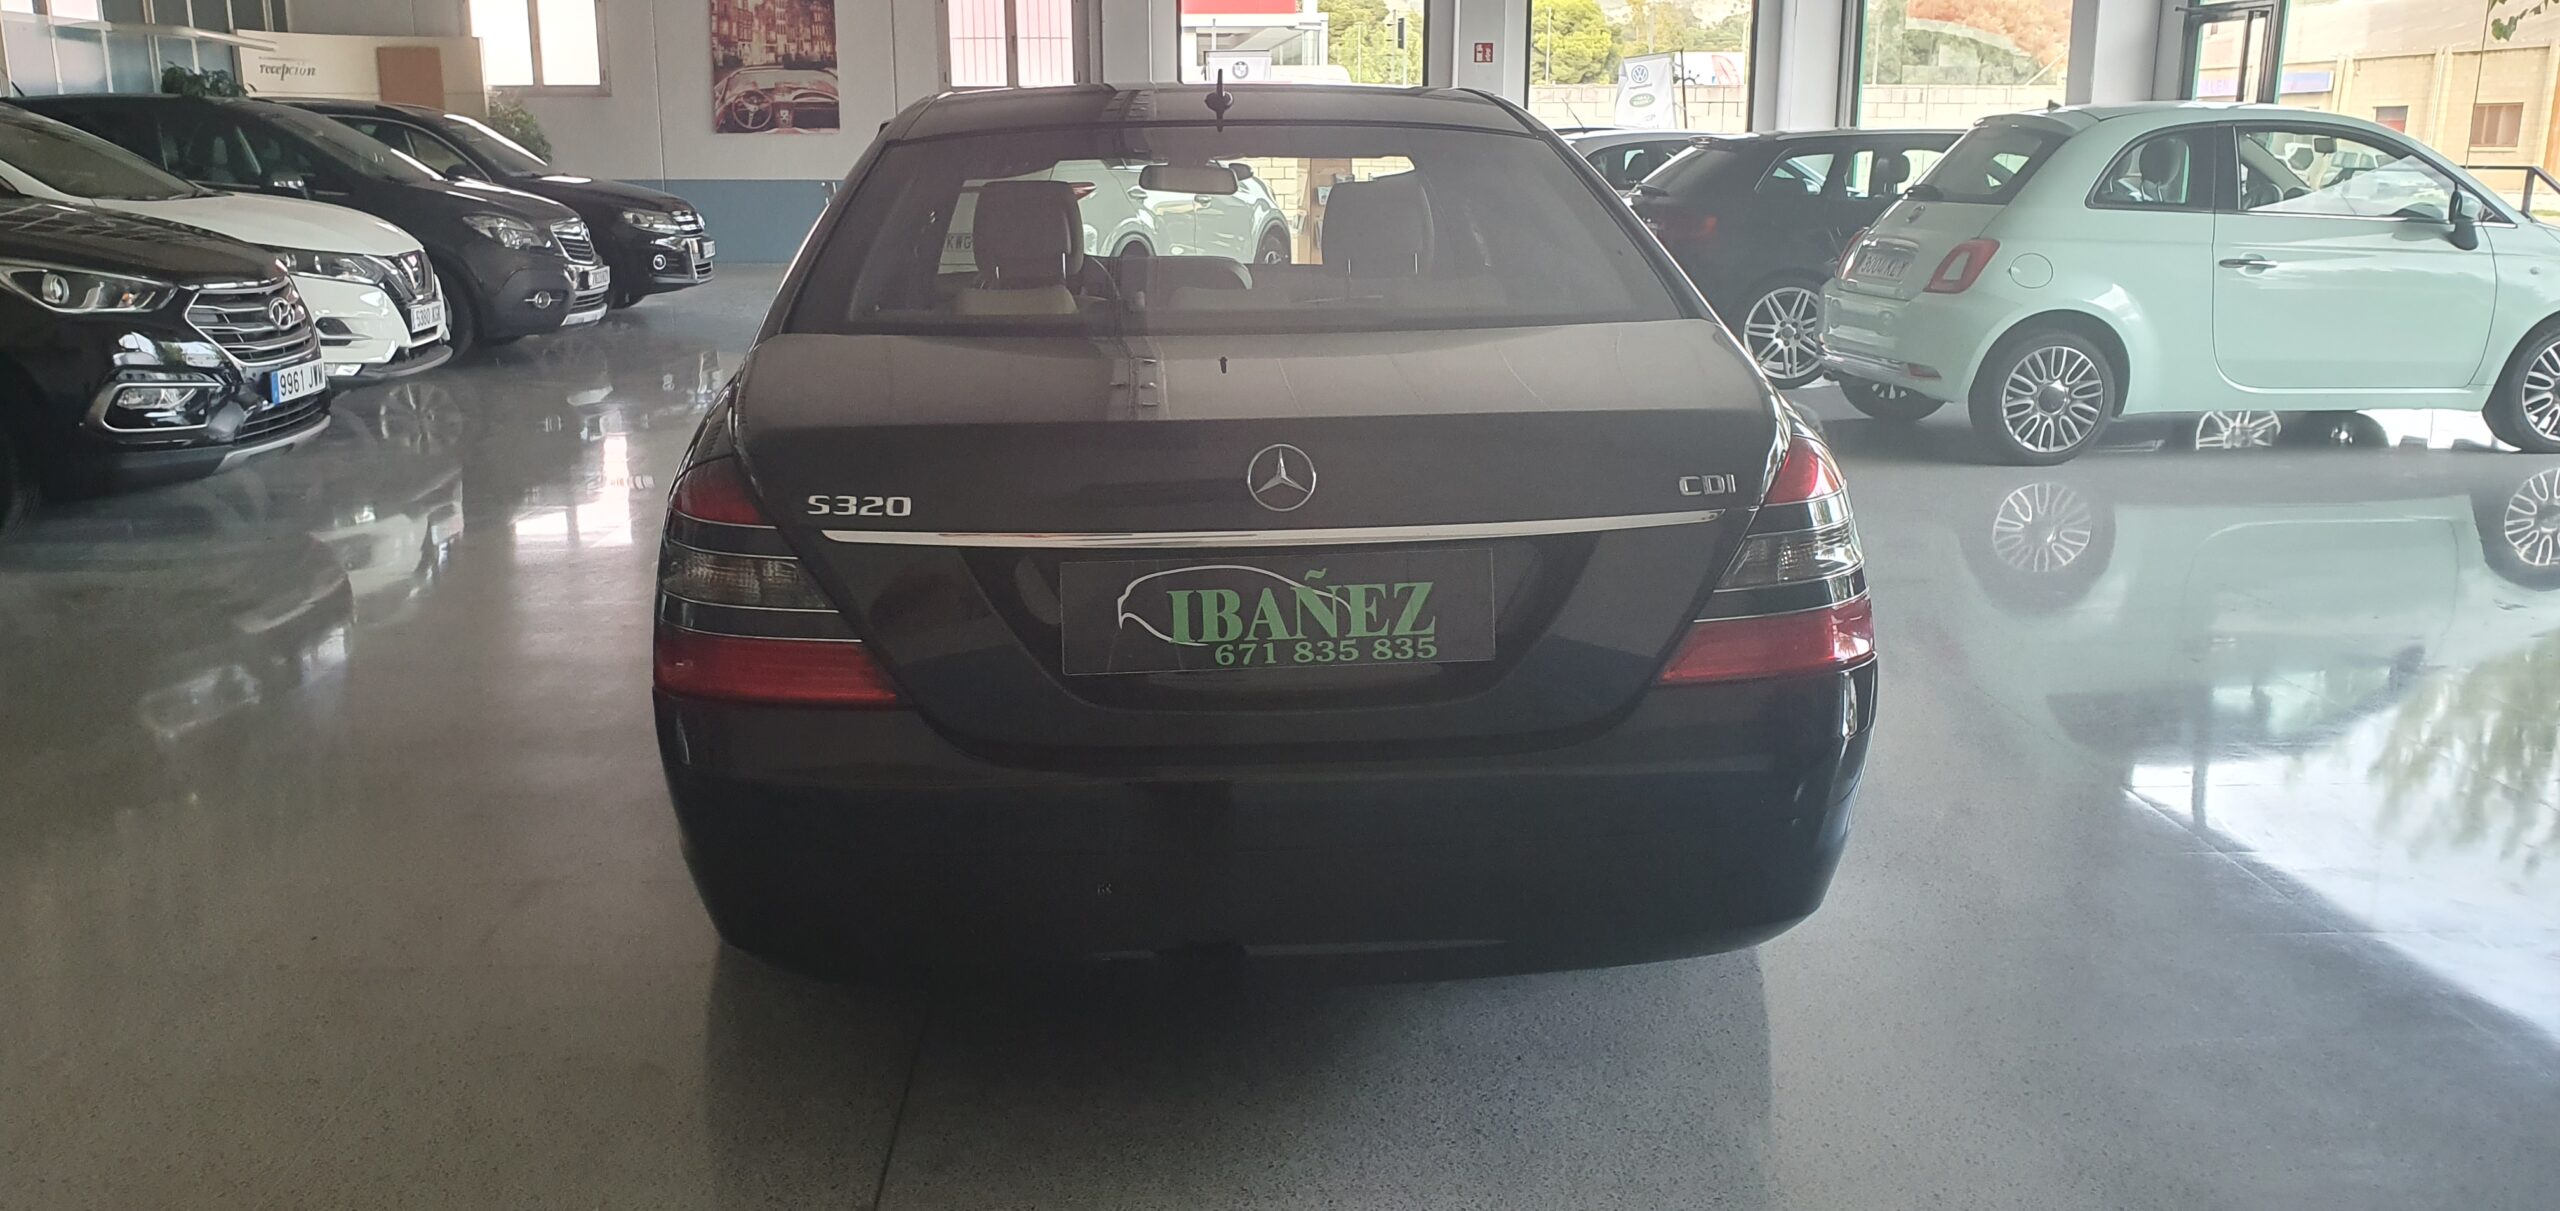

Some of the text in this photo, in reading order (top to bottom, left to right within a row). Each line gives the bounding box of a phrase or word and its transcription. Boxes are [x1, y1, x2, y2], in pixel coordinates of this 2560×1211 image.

[280, 369, 304, 396] 9961
[1679, 474, 1736, 496] CDI
[807, 495, 912, 517] S320
[1166, 568, 1436, 644] IBAÑEZ
[1214, 636, 1438, 666] 671 835 835
